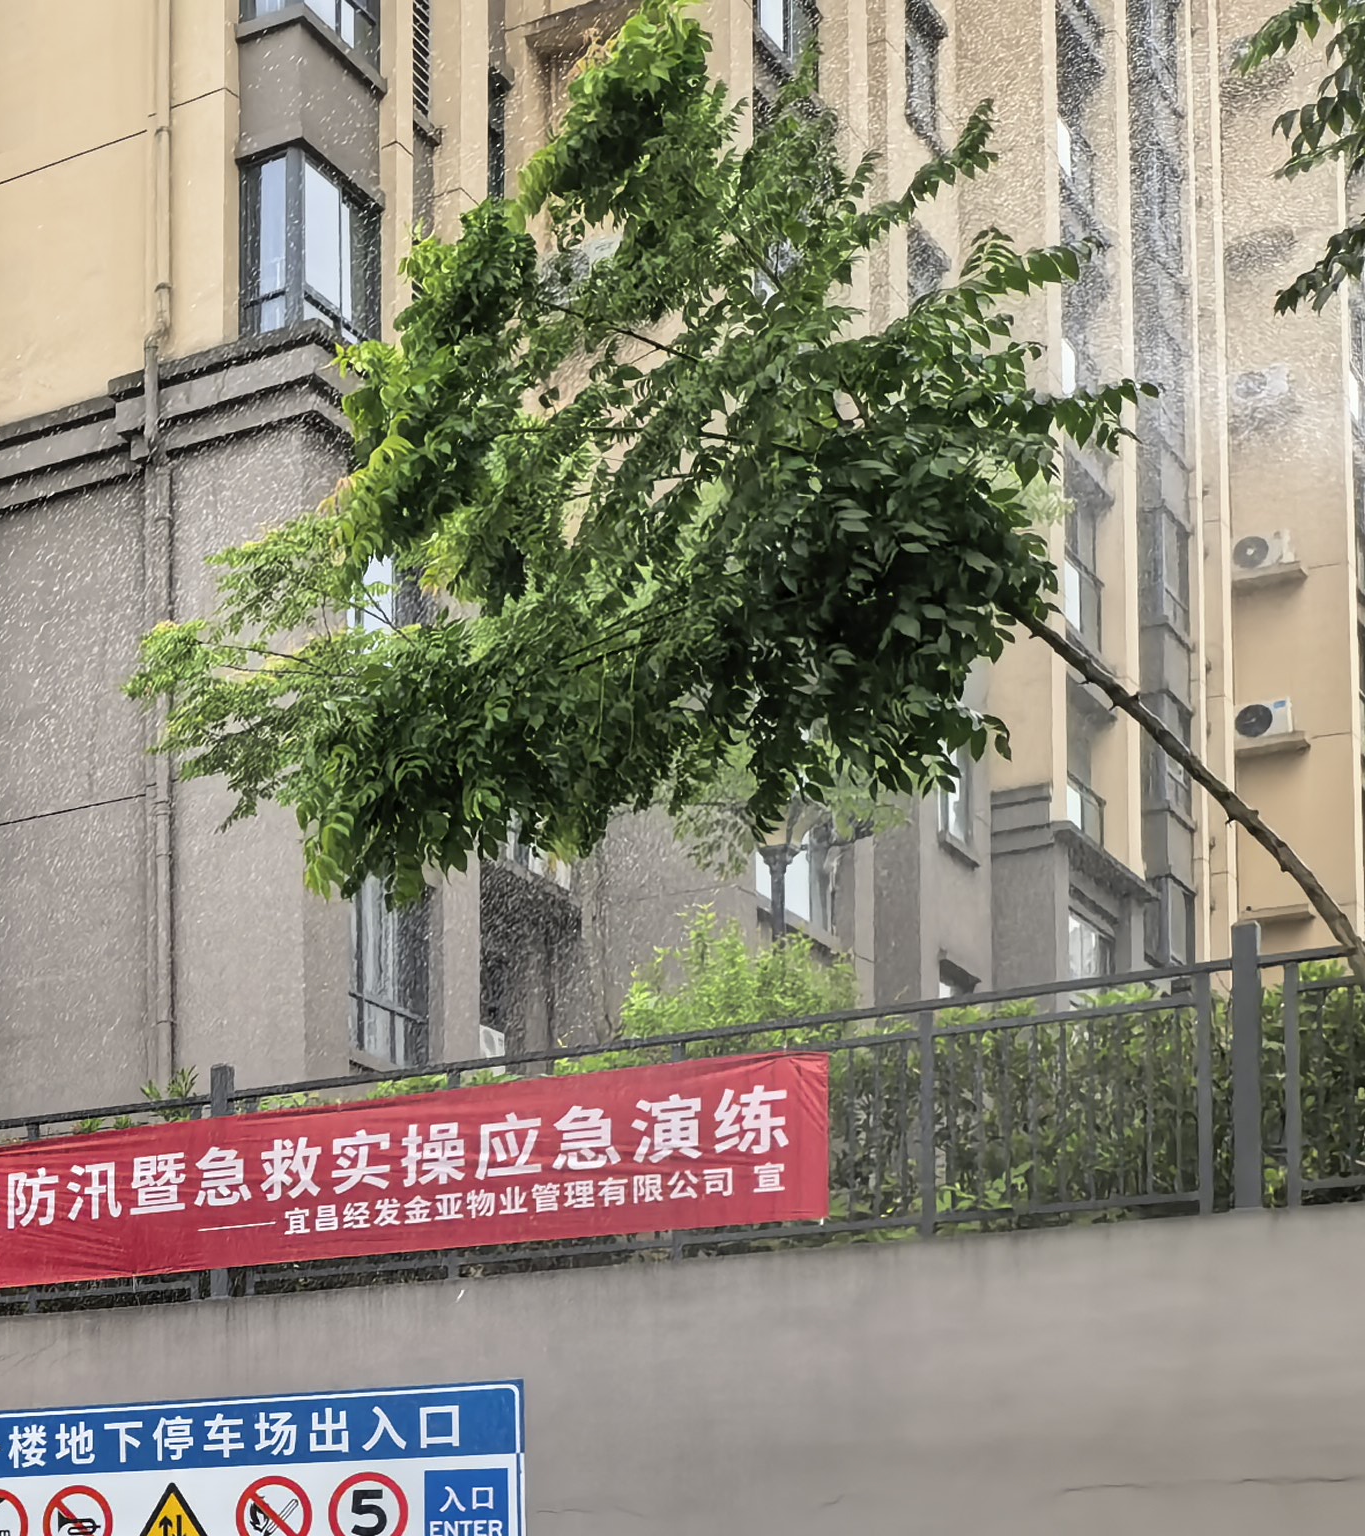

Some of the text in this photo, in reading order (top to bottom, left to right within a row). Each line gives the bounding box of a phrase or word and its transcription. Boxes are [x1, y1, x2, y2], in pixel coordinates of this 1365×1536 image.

[753, 1162, 787, 1194] 宣
[351, 1489, 387, 1536] 5
[439, 1485, 494, 1513] 入口
